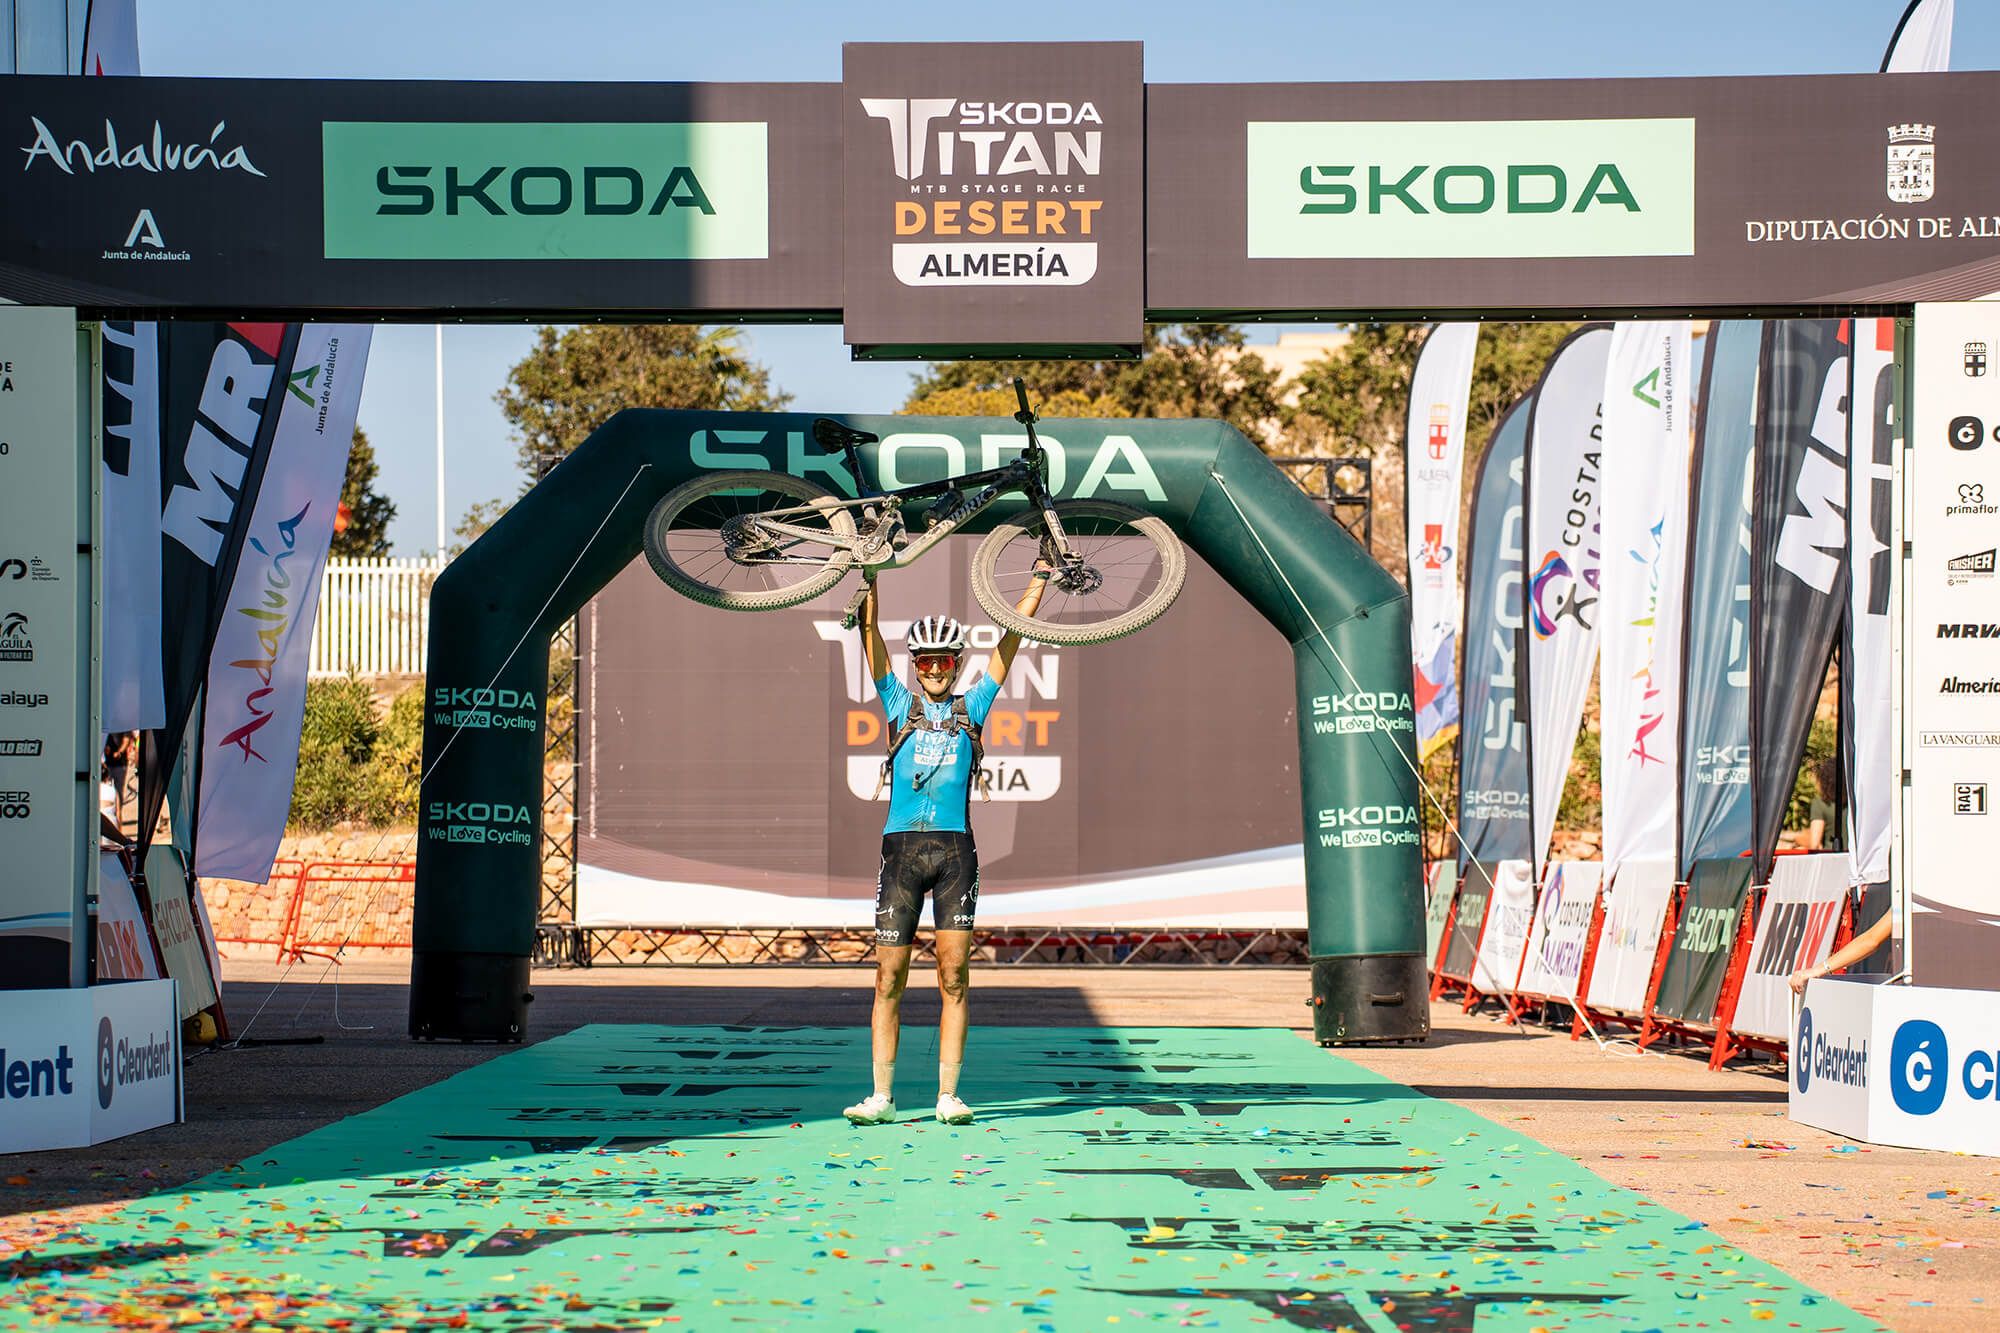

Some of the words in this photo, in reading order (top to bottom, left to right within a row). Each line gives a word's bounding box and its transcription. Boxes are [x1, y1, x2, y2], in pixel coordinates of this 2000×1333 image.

[960, 102, 1103, 124] SKODA
[20, 116, 268, 178] Andalucía
[860, 98, 1101, 180] TITAN
[376, 167, 717, 215] SKODA
[911, 185, 947, 193] MTB
[961, 184, 1023, 193] STAGE
[1037, 184, 1086, 193] RACE
[1299, 164, 1642, 214] SKODA
[895, 200, 1103, 235] DESERT
[1745, 213, 1911, 242] DIPUTACIÓN
[1917, 217, 1953, 239] DE
[102, 250, 129, 260] Junta
[130, 250, 142, 260] de
[144, 250, 191, 261] Andalucía
[919, 246, 1069, 277] ALMERÍA
[323, 338, 339, 389] Andalucía
[321, 390, 331, 404] de
[315, 406, 329, 435] Junta
[1562, 452, 1602, 547] COSTA
[1946, 505, 1998, 517] primaflor
[0, 640, 33, 648] GUILA
[219, 500, 312, 764] Andalucía
[435, 688, 537, 710] SKODA
[1313, 692, 1413, 715] SKODA
[434, 713, 451, 725] We
[455, 712, 486, 727] Love
[493, 715, 537, 731] Cycling
[1314, 721, 1335, 734] We
[1340, 718, 1371, 731] Love
[1376, 717, 1414, 732] Cycling
[1958, 786, 1971, 812] RAC
[1973, 786, 1984, 812] 1
[429, 802, 532, 824] SKODA
[1319, 806, 1419, 828] SKODA
[429, 828, 446, 840] We
[451, 827, 482, 841] Love
[487, 831, 531, 845] Cycling
[1320, 834, 1341, 847] We
[1346, 831, 1377, 844] Love
[1382, 831, 1420, 845] Cycling
[1680, 906, 1736, 953] SKODA
[1755, 901, 1836, 976] MRW
[117, 1031, 171, 1086] Cleardent
[1814, 1032, 1867, 1088] Cleardent
